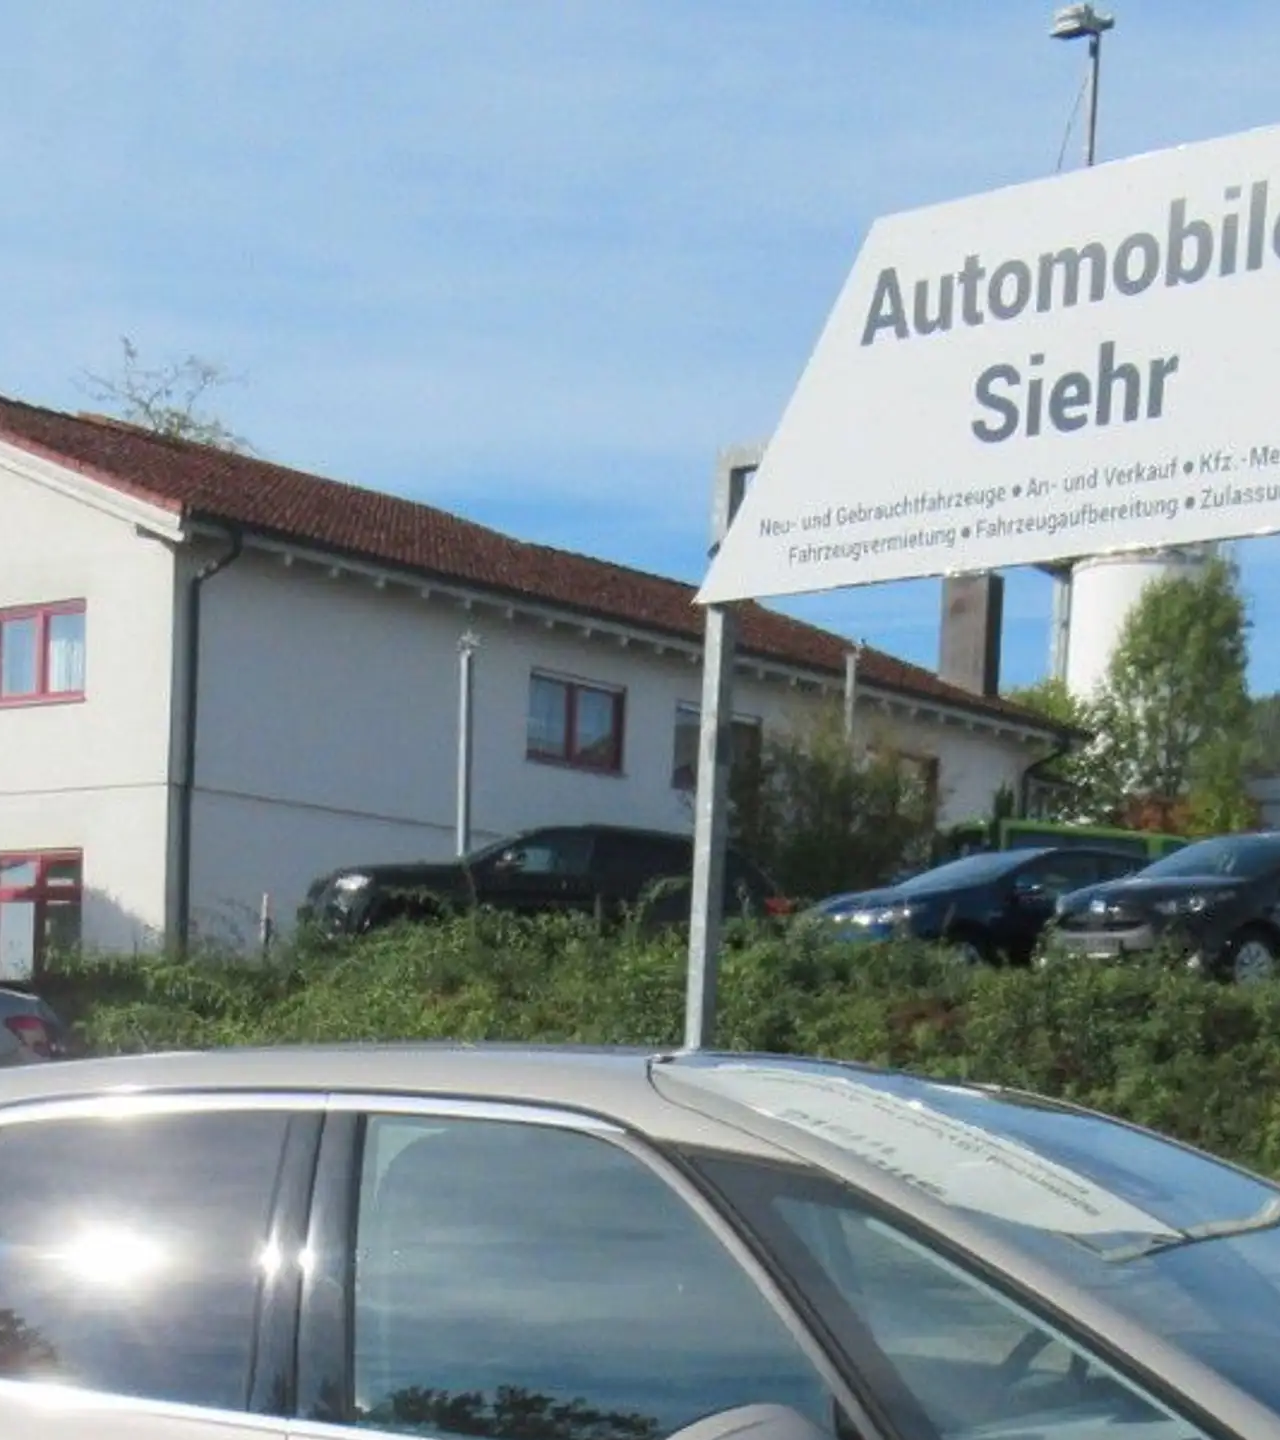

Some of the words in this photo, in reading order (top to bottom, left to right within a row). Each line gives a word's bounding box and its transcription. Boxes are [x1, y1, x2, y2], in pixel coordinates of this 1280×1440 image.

[970, 340, 1180, 443] Siehr
[759, 517, 797, 538] Neu-
[801, 511, 832, 532] und
[835, 484, 1007, 527] Gebrauchtfahrzeuge
[1025, 477, 1057, 498] An-
[1063, 468, 1098, 491] und
[1103, 456, 1179, 486] Verkauf
[787, 525, 957, 568] Fahrzeugvermietung
[975, 496, 1180, 538] Fahrzeugaufbereitung
